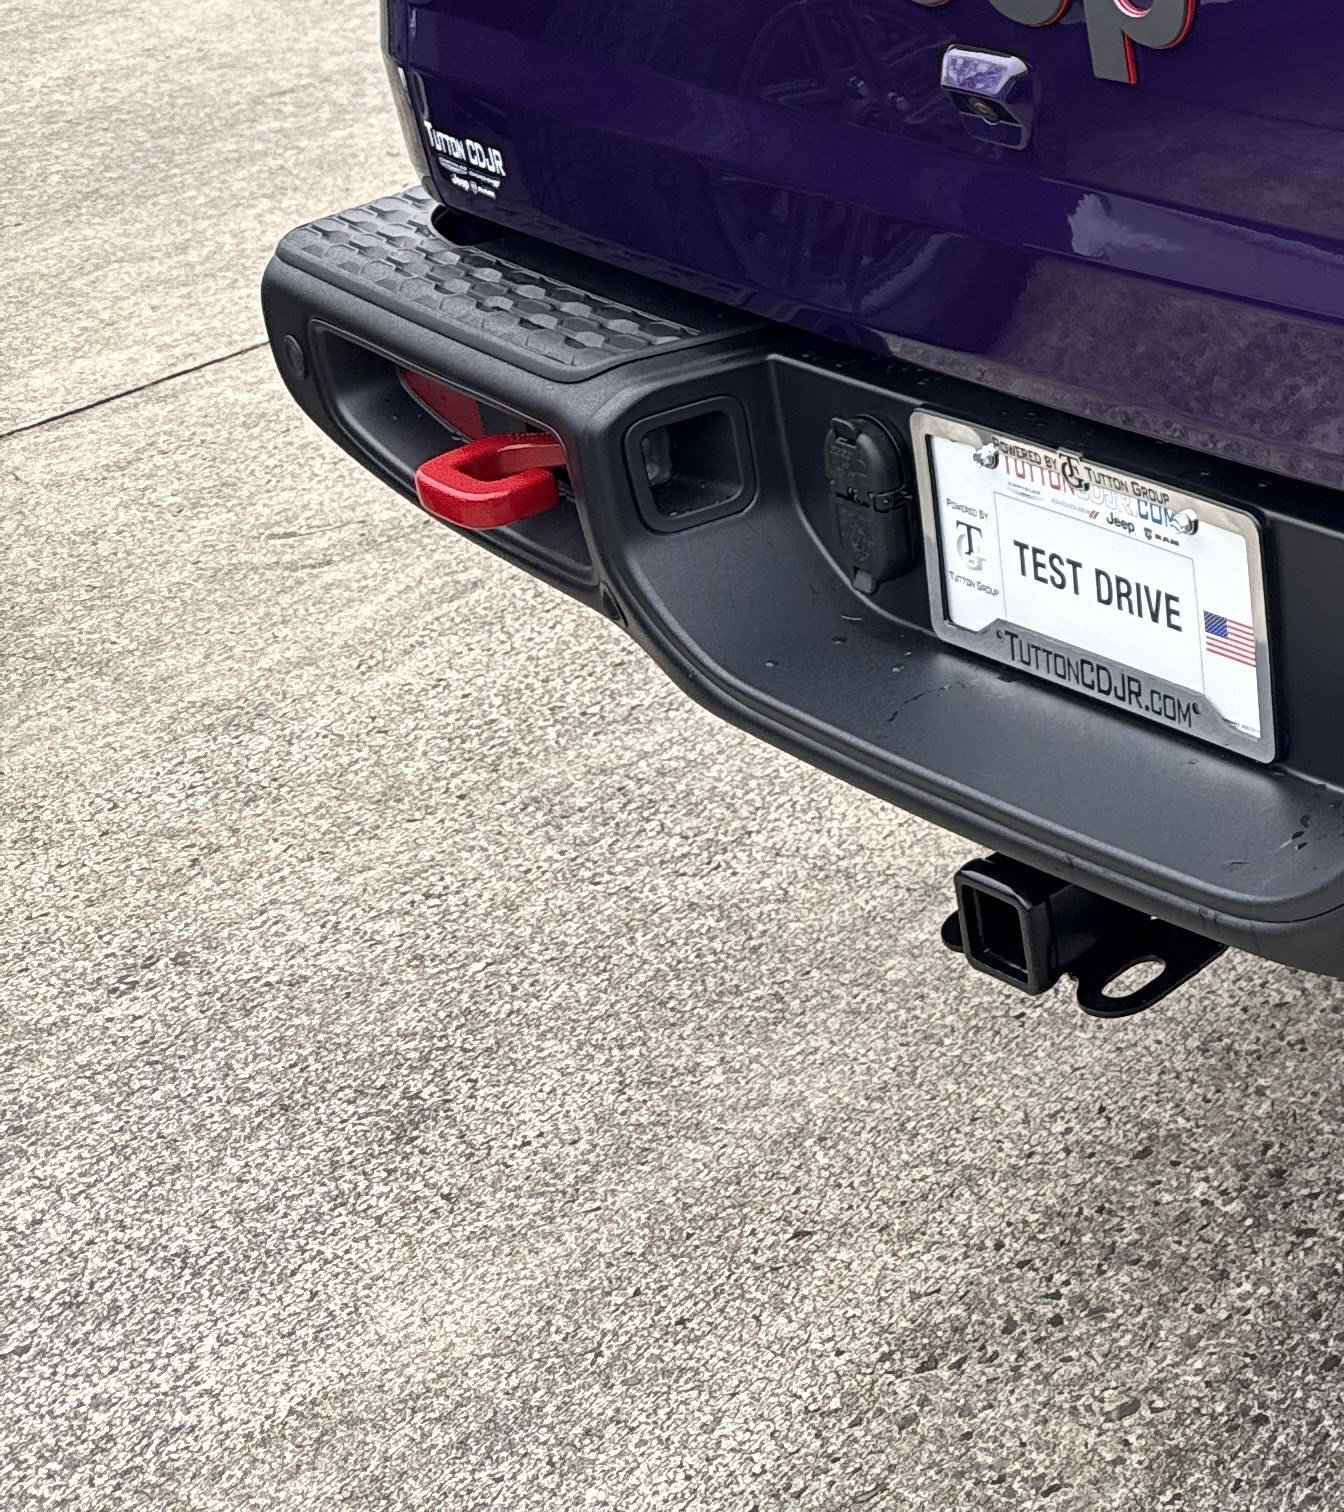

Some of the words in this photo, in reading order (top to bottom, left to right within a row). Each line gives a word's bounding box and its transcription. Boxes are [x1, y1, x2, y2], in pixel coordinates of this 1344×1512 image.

[465, 138, 507, 177] CDJR
[992, 436, 1042, 465] POWERED
[1043, 454, 1058, 470] BY
[1083, 466, 1129, 493] TUTTON
[1130, 480, 1171, 506] GROUP
[1105, 511, 1136, 535] Jeep
[1012, 539, 1083, 596] TEST
[1094, 567, 1183, 633] DRIVE
[1004, 629, 1193, 729] TUTTONCDJR.COM
